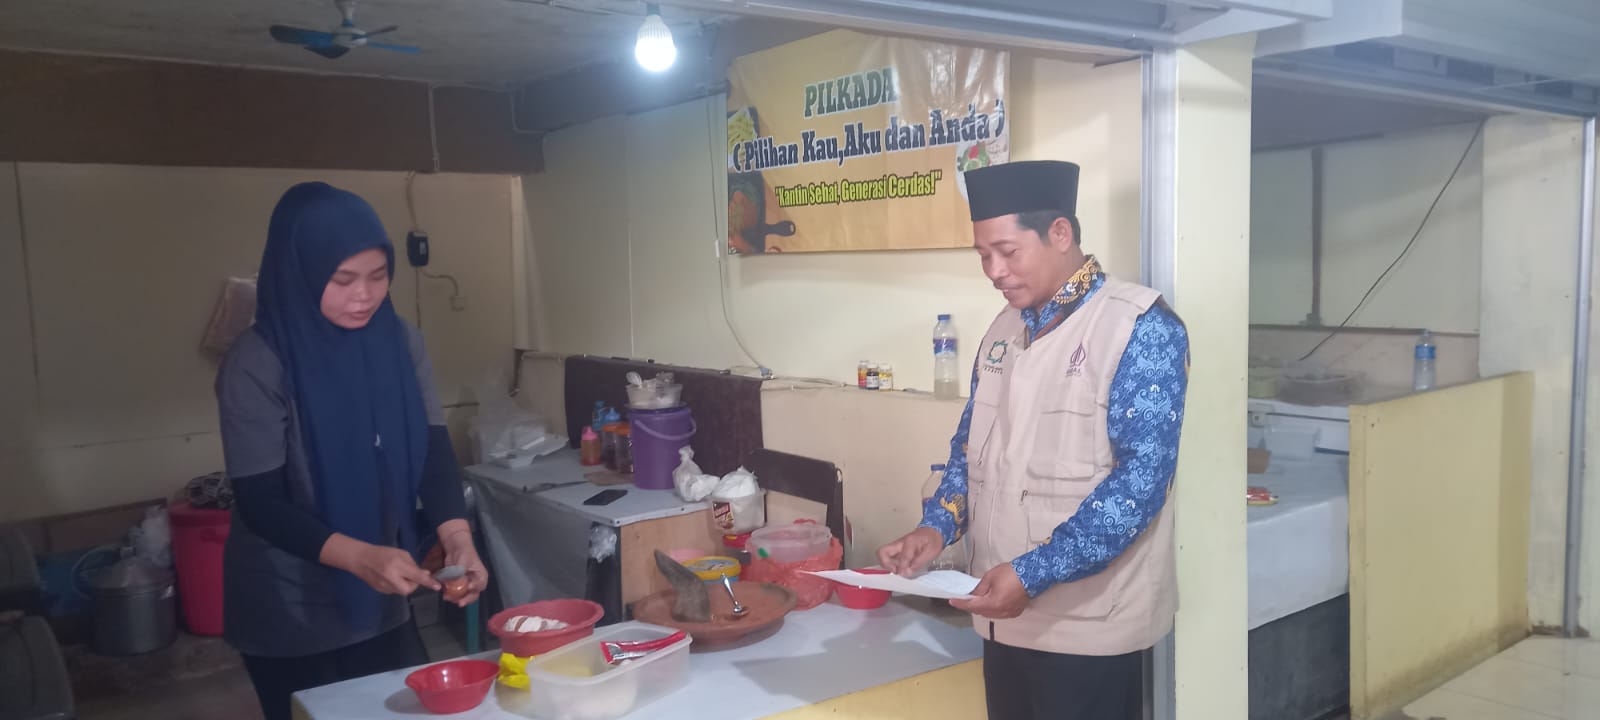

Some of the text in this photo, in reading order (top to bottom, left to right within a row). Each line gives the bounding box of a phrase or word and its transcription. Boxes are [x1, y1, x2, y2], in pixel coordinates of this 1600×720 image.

[804, 67, 898, 118] PILKADA
[884, 116, 926, 152] dan
[840, 174, 888, 202] Generasi
[887, 169, 943, 199] Cerdas!"
